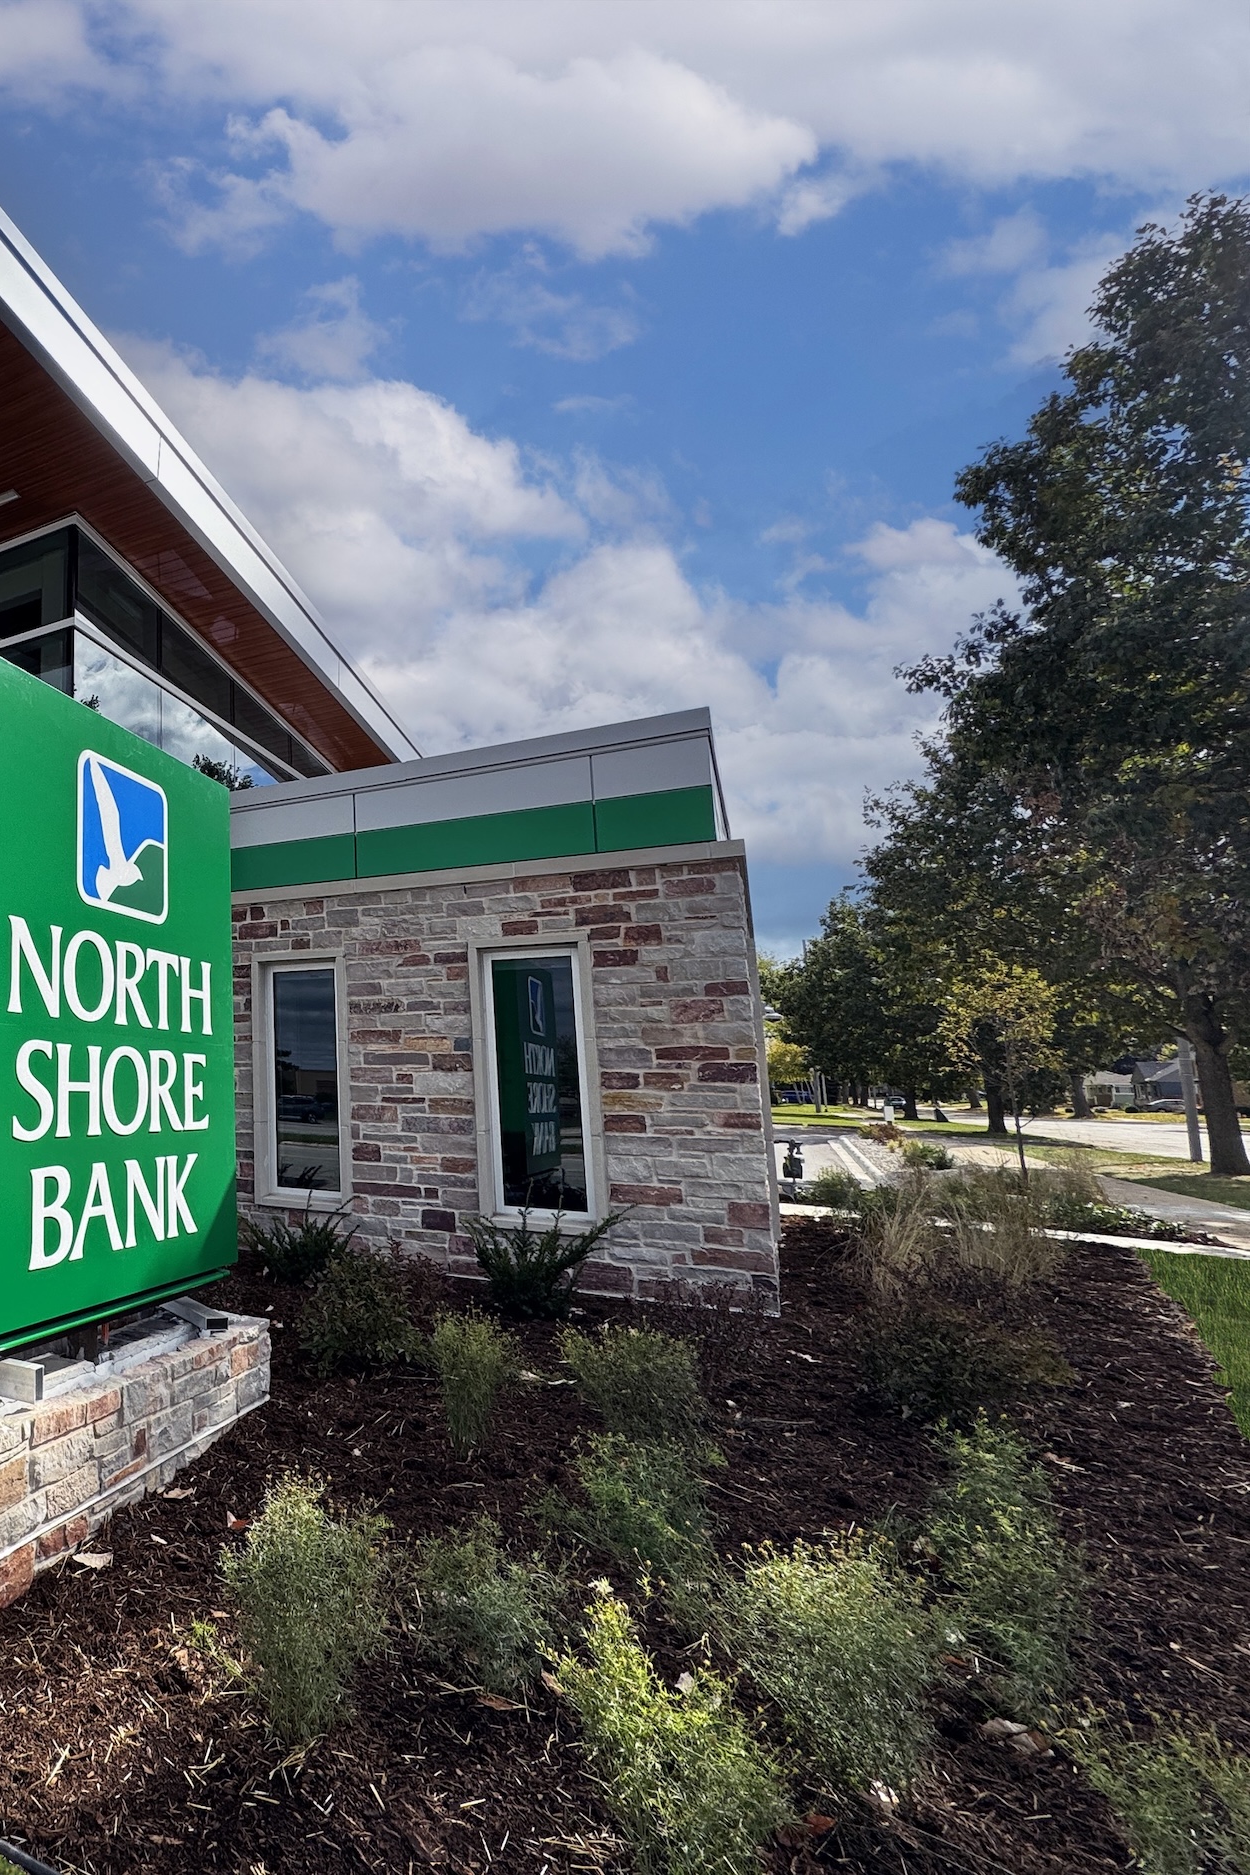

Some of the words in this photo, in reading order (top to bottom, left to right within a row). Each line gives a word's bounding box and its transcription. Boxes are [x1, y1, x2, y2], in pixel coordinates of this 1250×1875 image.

[6, 914, 213, 1036] NORTH
[12, 1039, 210, 1142] SHORE
[28, 1152, 199, 1271] BANK
